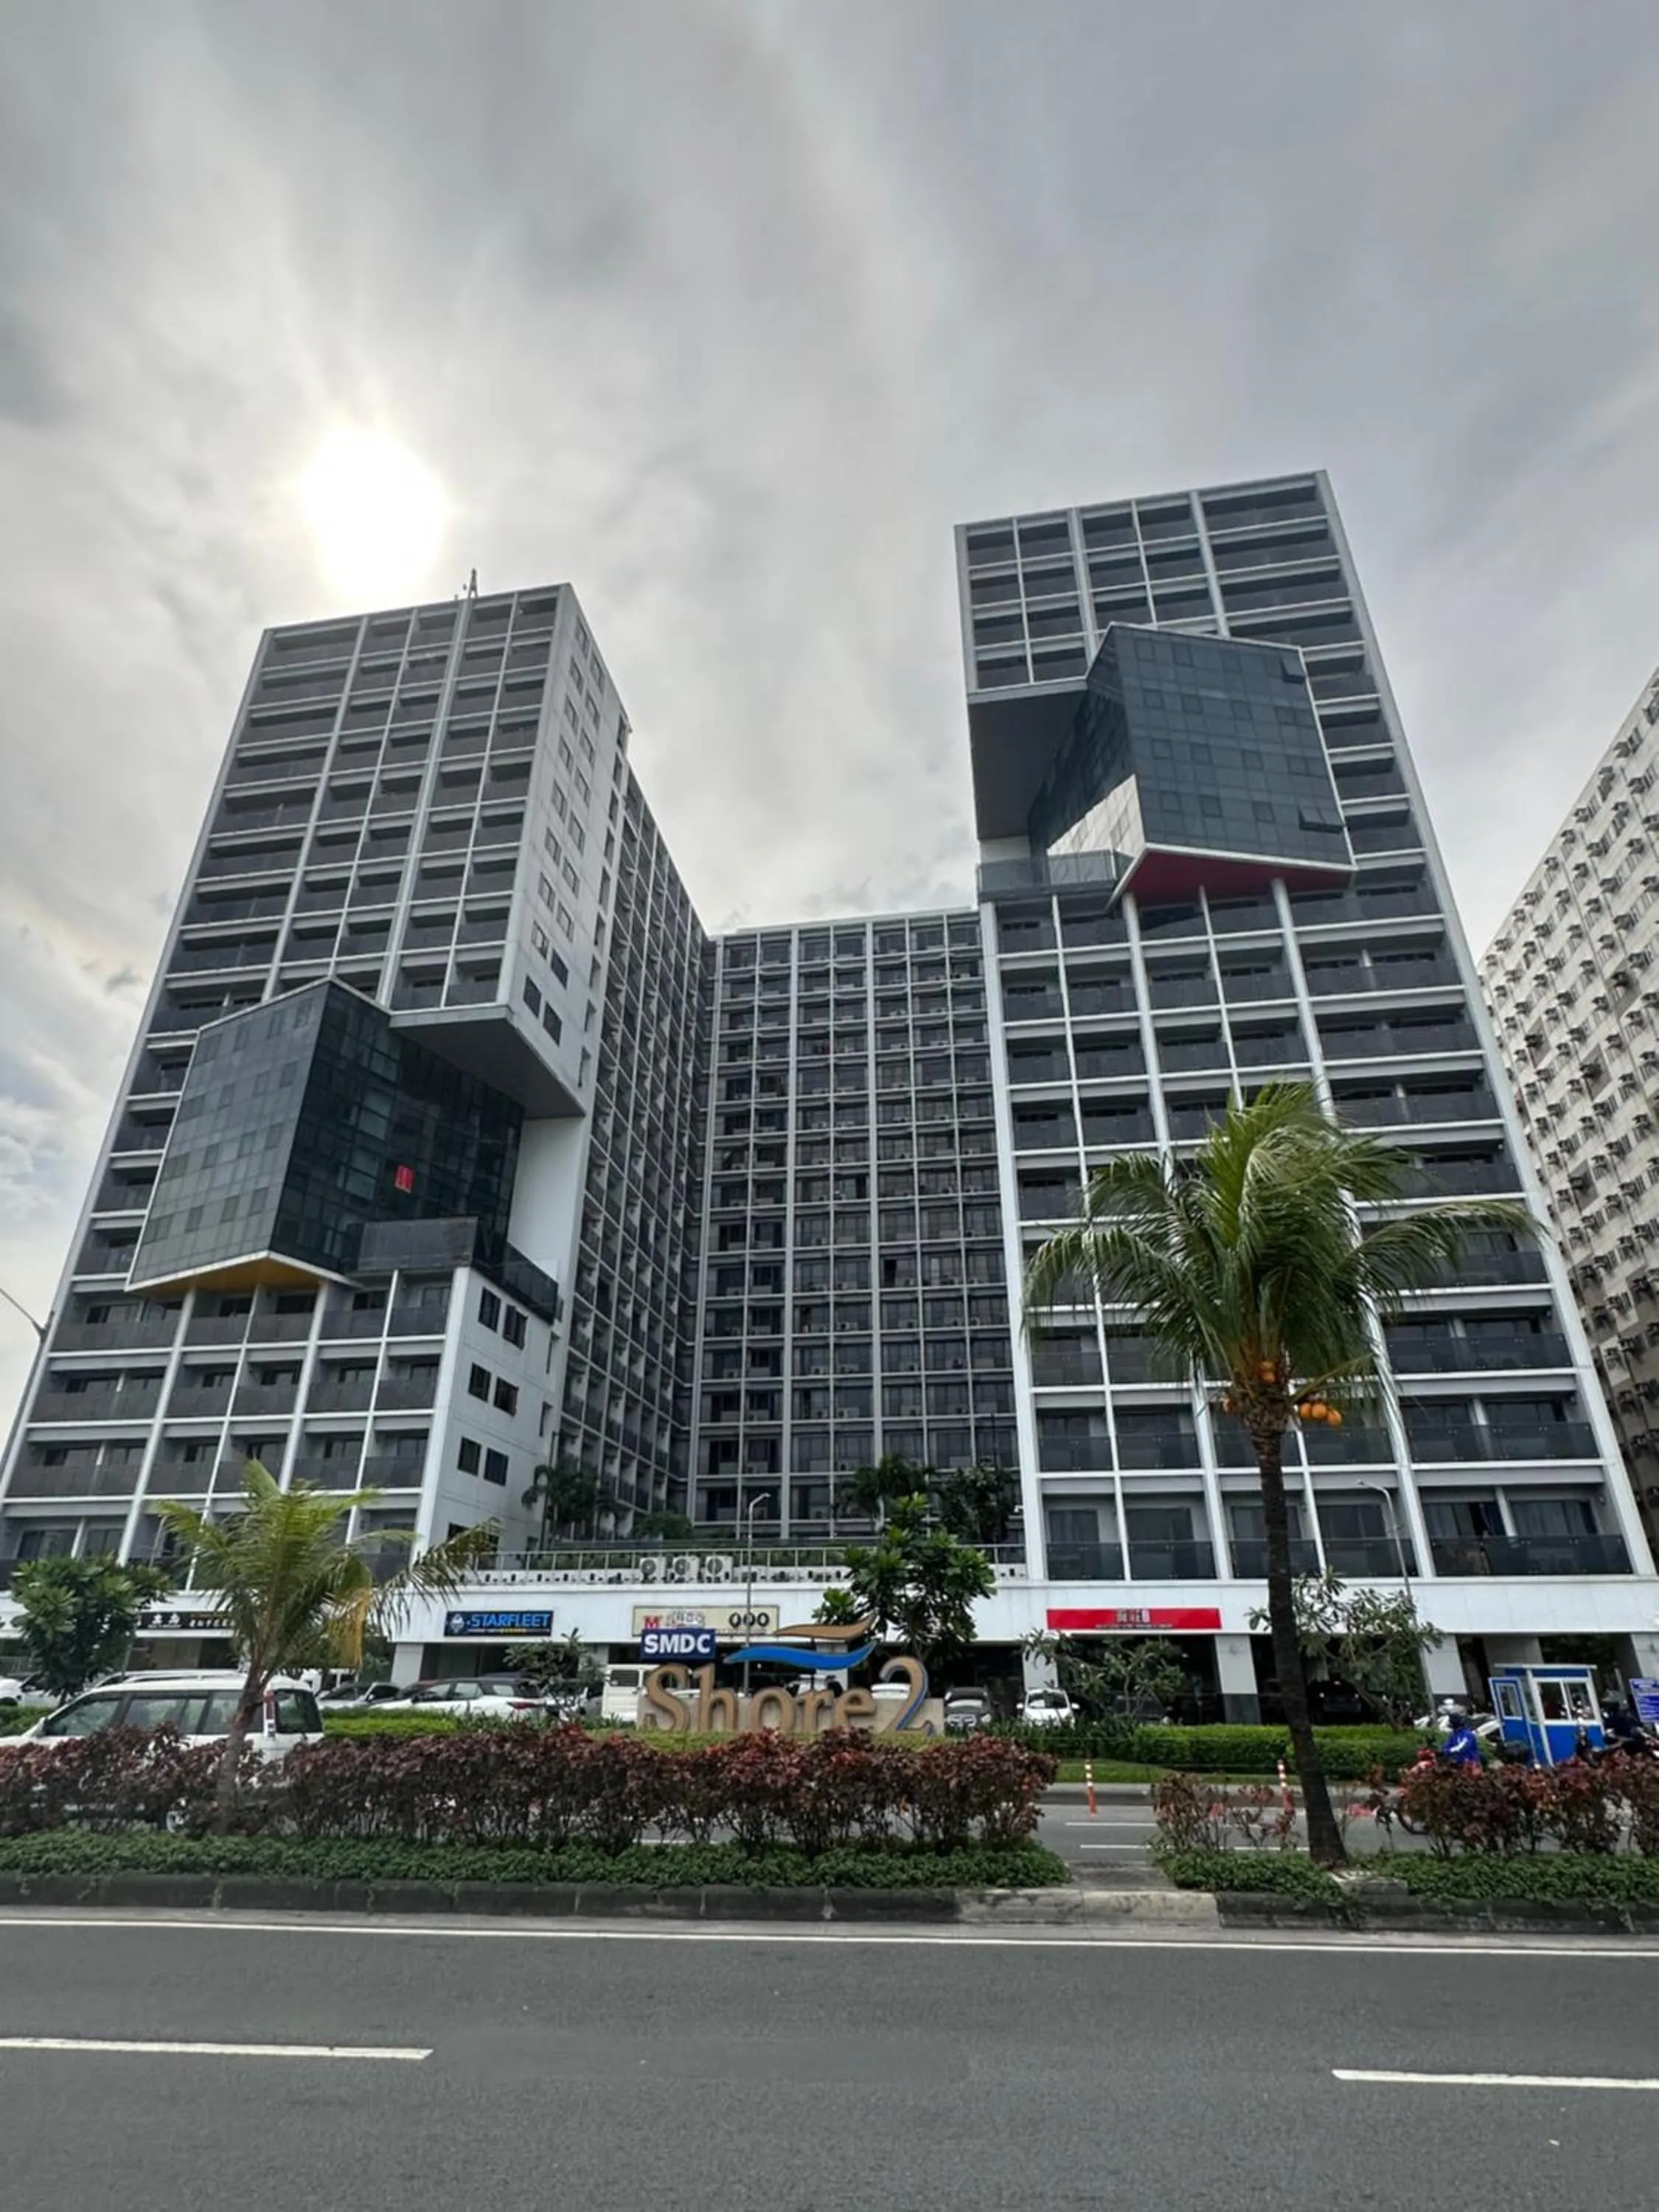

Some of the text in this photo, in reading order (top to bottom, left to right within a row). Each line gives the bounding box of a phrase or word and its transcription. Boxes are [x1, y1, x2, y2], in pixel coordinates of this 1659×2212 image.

[470, 1613, 550, 1628] STARFLEET
[644, 1633, 712, 1655] SMDC
[644, 1656, 935, 1736] Shore 2
